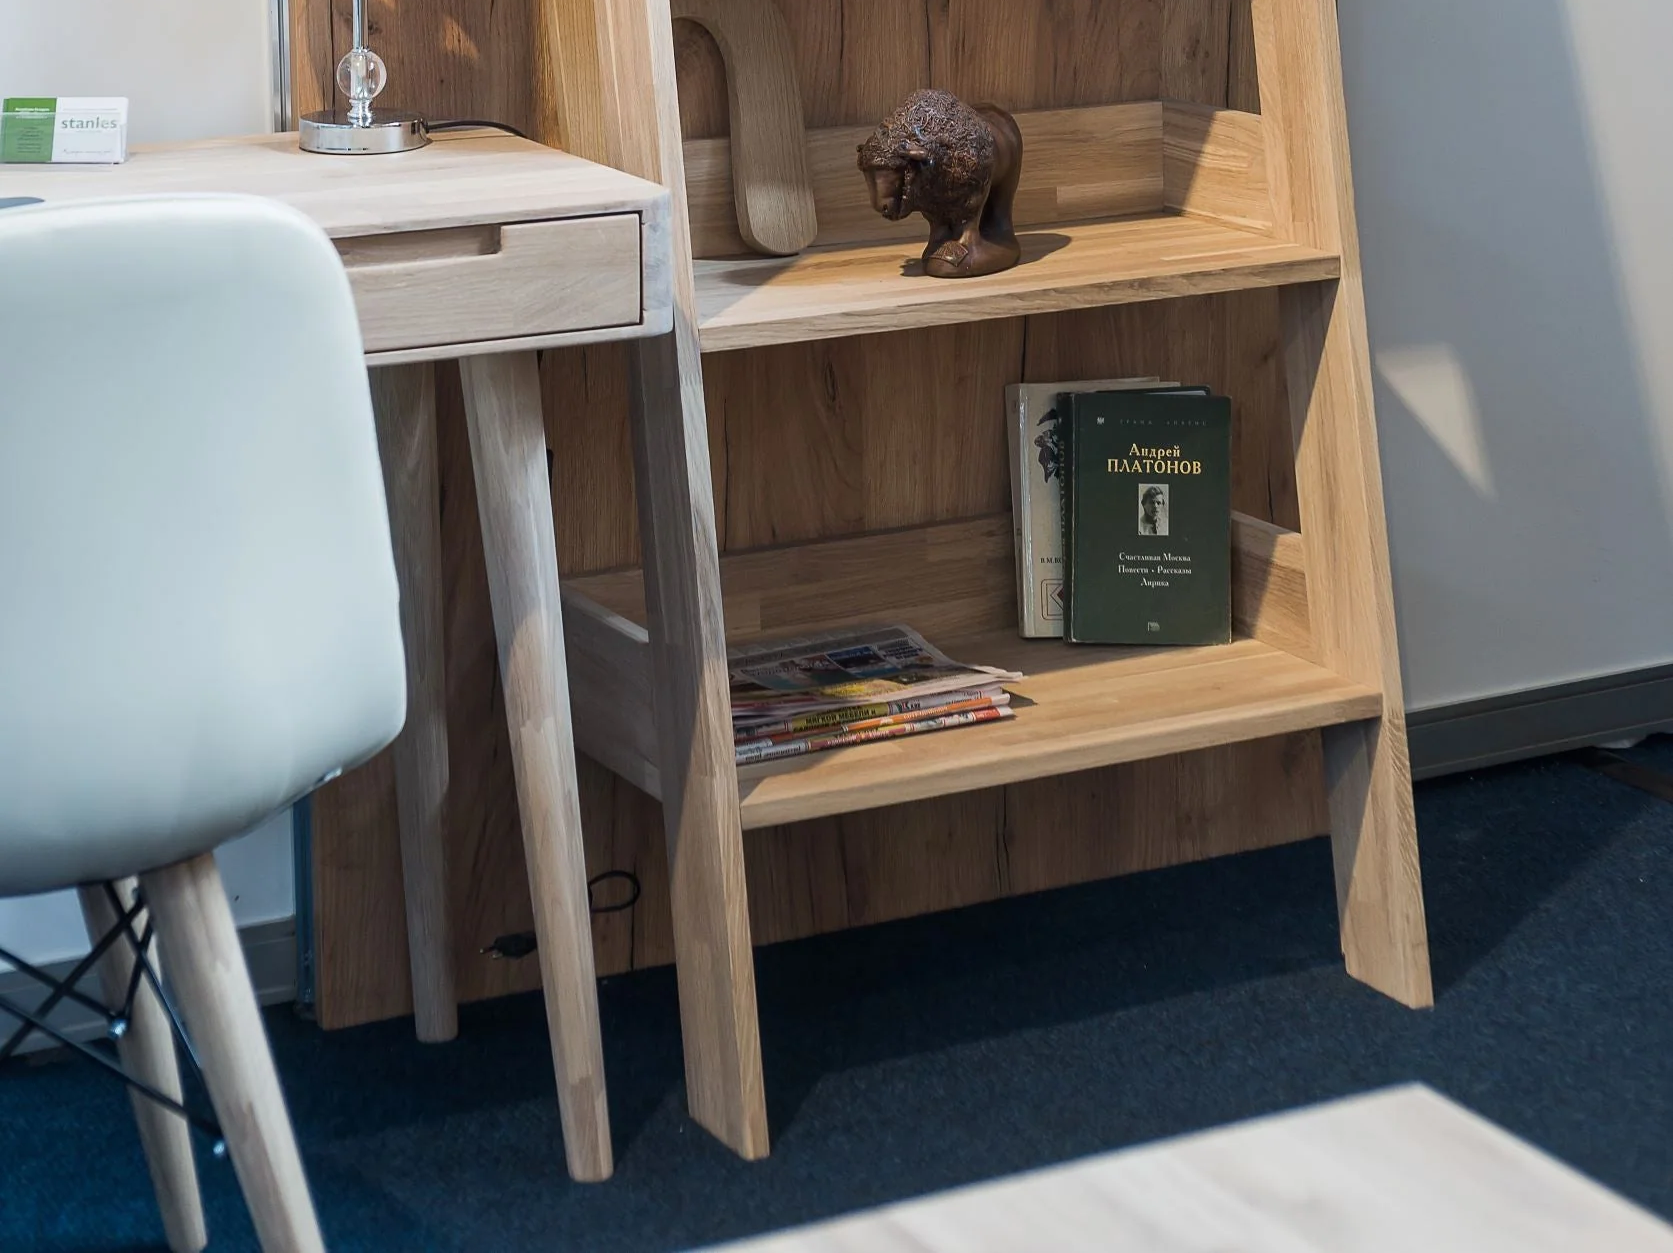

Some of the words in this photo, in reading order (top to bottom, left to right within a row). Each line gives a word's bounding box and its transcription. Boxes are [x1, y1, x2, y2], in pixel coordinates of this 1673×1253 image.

[61, 116, 117, 129] stanles
[1129, 443, 1180, 458] Андрей
[1107, 459, 1202, 475] ПЛАТОНОВ
[1119, 552, 1161, 561] Счастливая
[1163, 553, 1191, 562] Москва
[1118, 565, 1149, 574] Повести
[1157, 567, 1192, 576] Рассказы
[1141, 578, 1170, 589] Лирика
